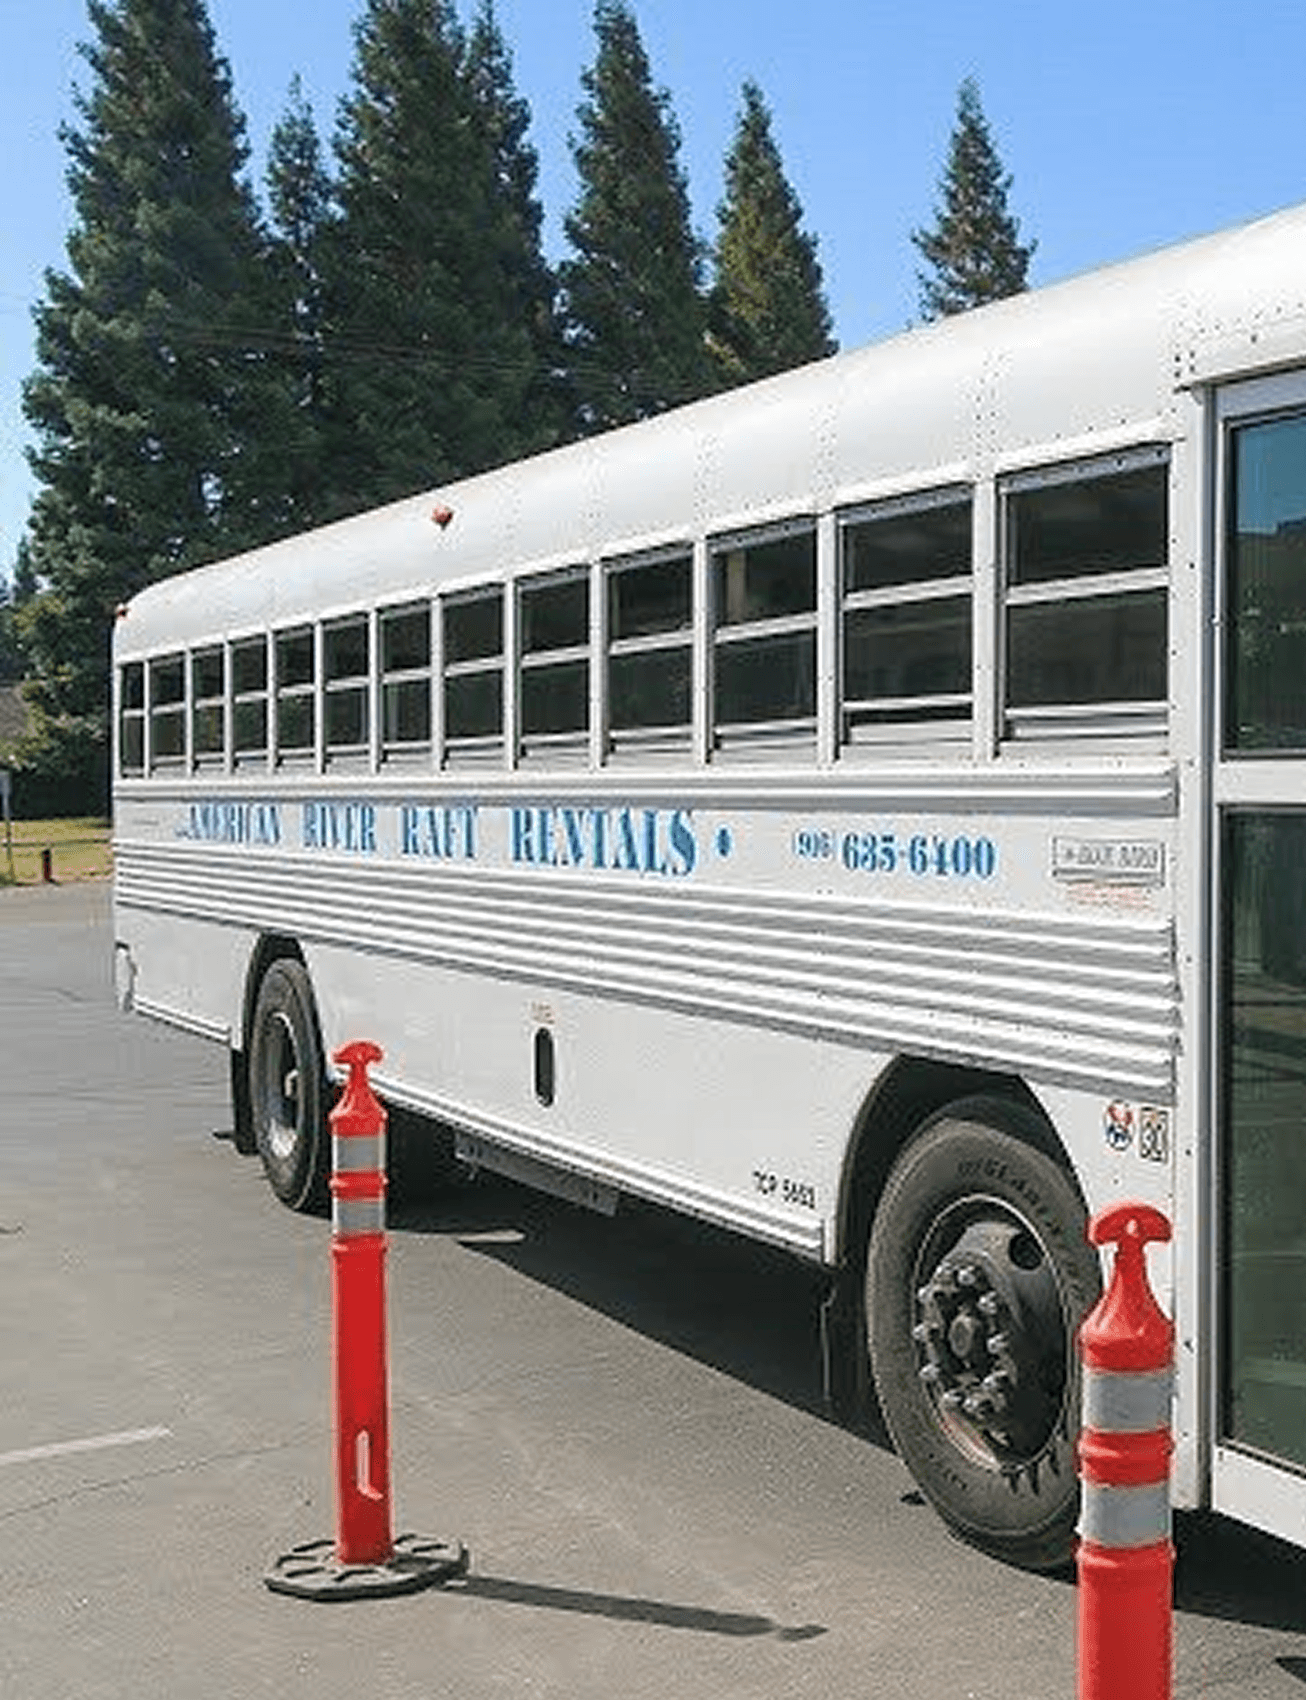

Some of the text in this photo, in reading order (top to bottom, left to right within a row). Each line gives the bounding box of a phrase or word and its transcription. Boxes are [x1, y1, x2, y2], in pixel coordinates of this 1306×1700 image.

[178, 803, 697, 876] AMERICAN RIVER RAFT RENTALS
